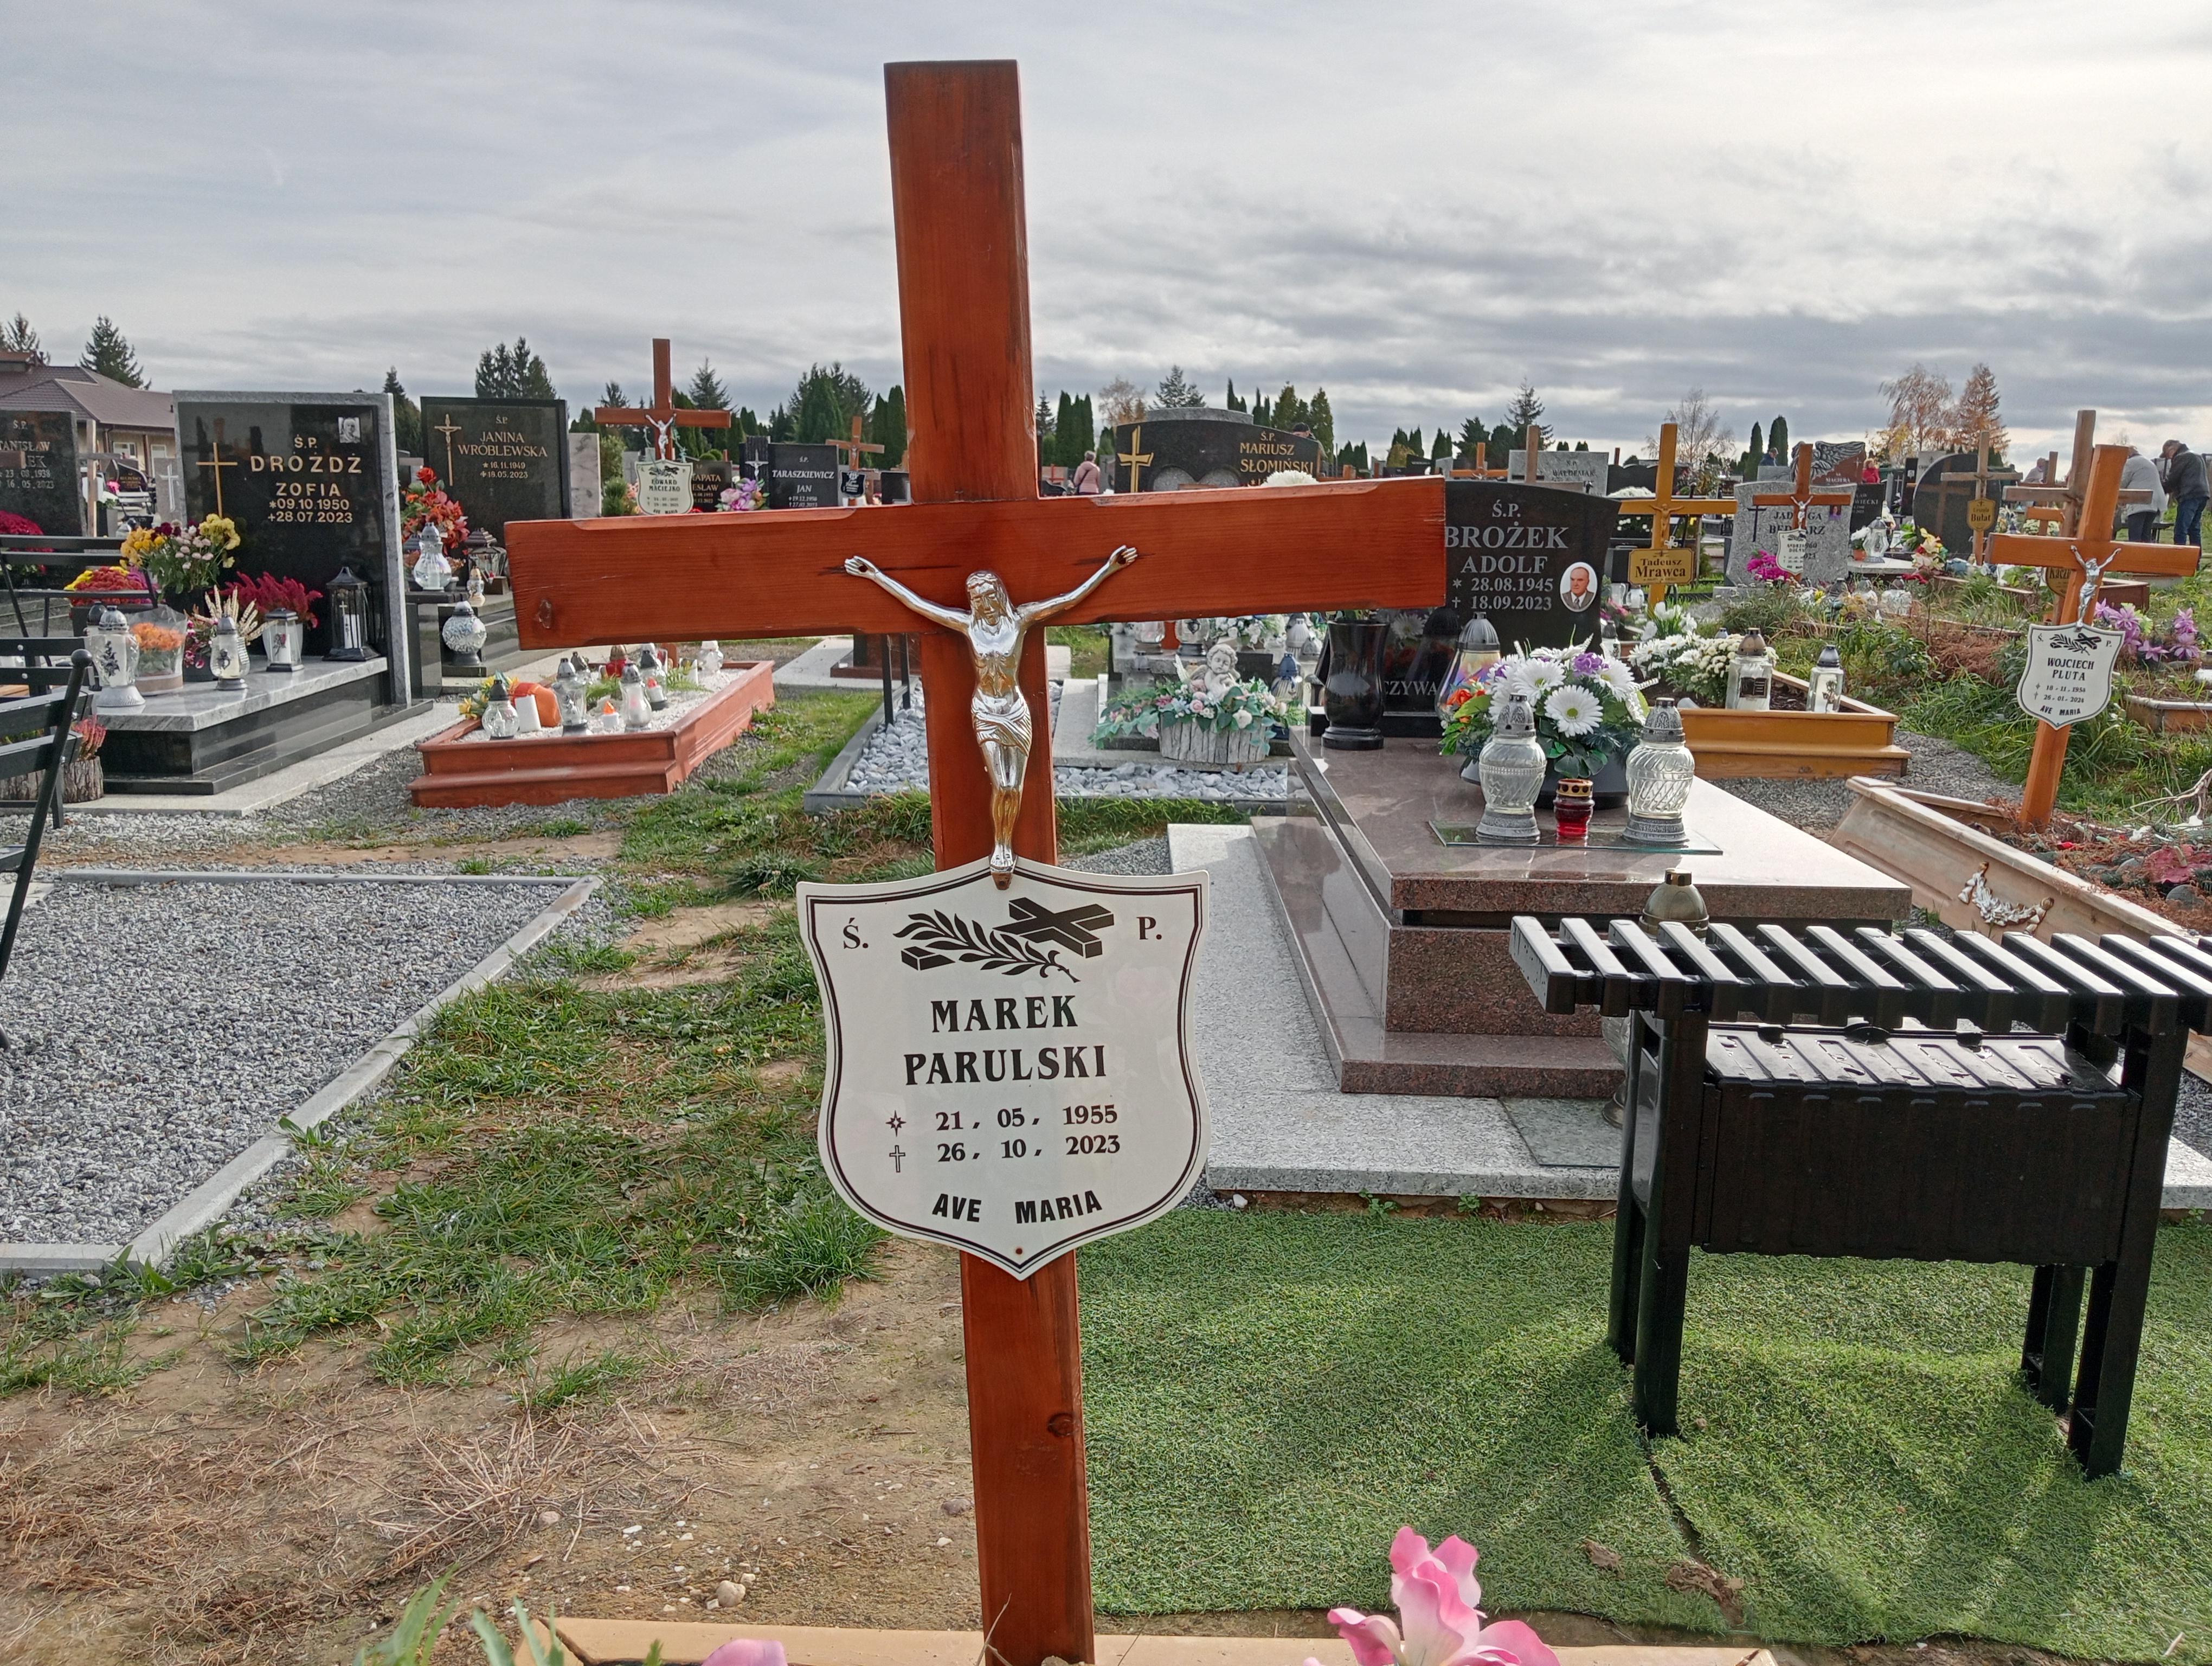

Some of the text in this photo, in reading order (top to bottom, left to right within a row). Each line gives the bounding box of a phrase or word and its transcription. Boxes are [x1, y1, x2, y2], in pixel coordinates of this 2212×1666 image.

[480, 432, 525, 443] JANINA
[1261, 431, 1276, 441] Ś.P.
[458, 442, 548, 457] WRÓBLEWSKA
[1239, 442, 1295, 456] MARIUSZ
[1239, 458, 1314, 474] SŁOMIŃSKI
[772, 470, 834, 479] TARASZKIEWICZ
[276, 482, 341, 496] ZOFIA
[796, 484, 813, 494] JAN
[1492, 499, 1521, 517] Ś.P.
[1445, 521, 1569, 549] BROŻEK
[1461, 555, 1548, 574] ADOLF
[1635, 566, 1686, 578] Mrawca
[1471, 577, 1554, 592] 28.08.1945
[1470, 595, 1552, 611] 18.09.2023
[2047, 657, 2095, 670] WOJCIECH
[2052, 669, 2086, 681] PLUTA
[2040, 705, 2053, 714] AVE
[843, 916, 1162, 950] Ś. P.
[931, 995, 1078, 1033] MAREK
[903, 1045, 1107, 1085] PARULSKI
[932, 1190, 1103, 1224] AVE MARIA
